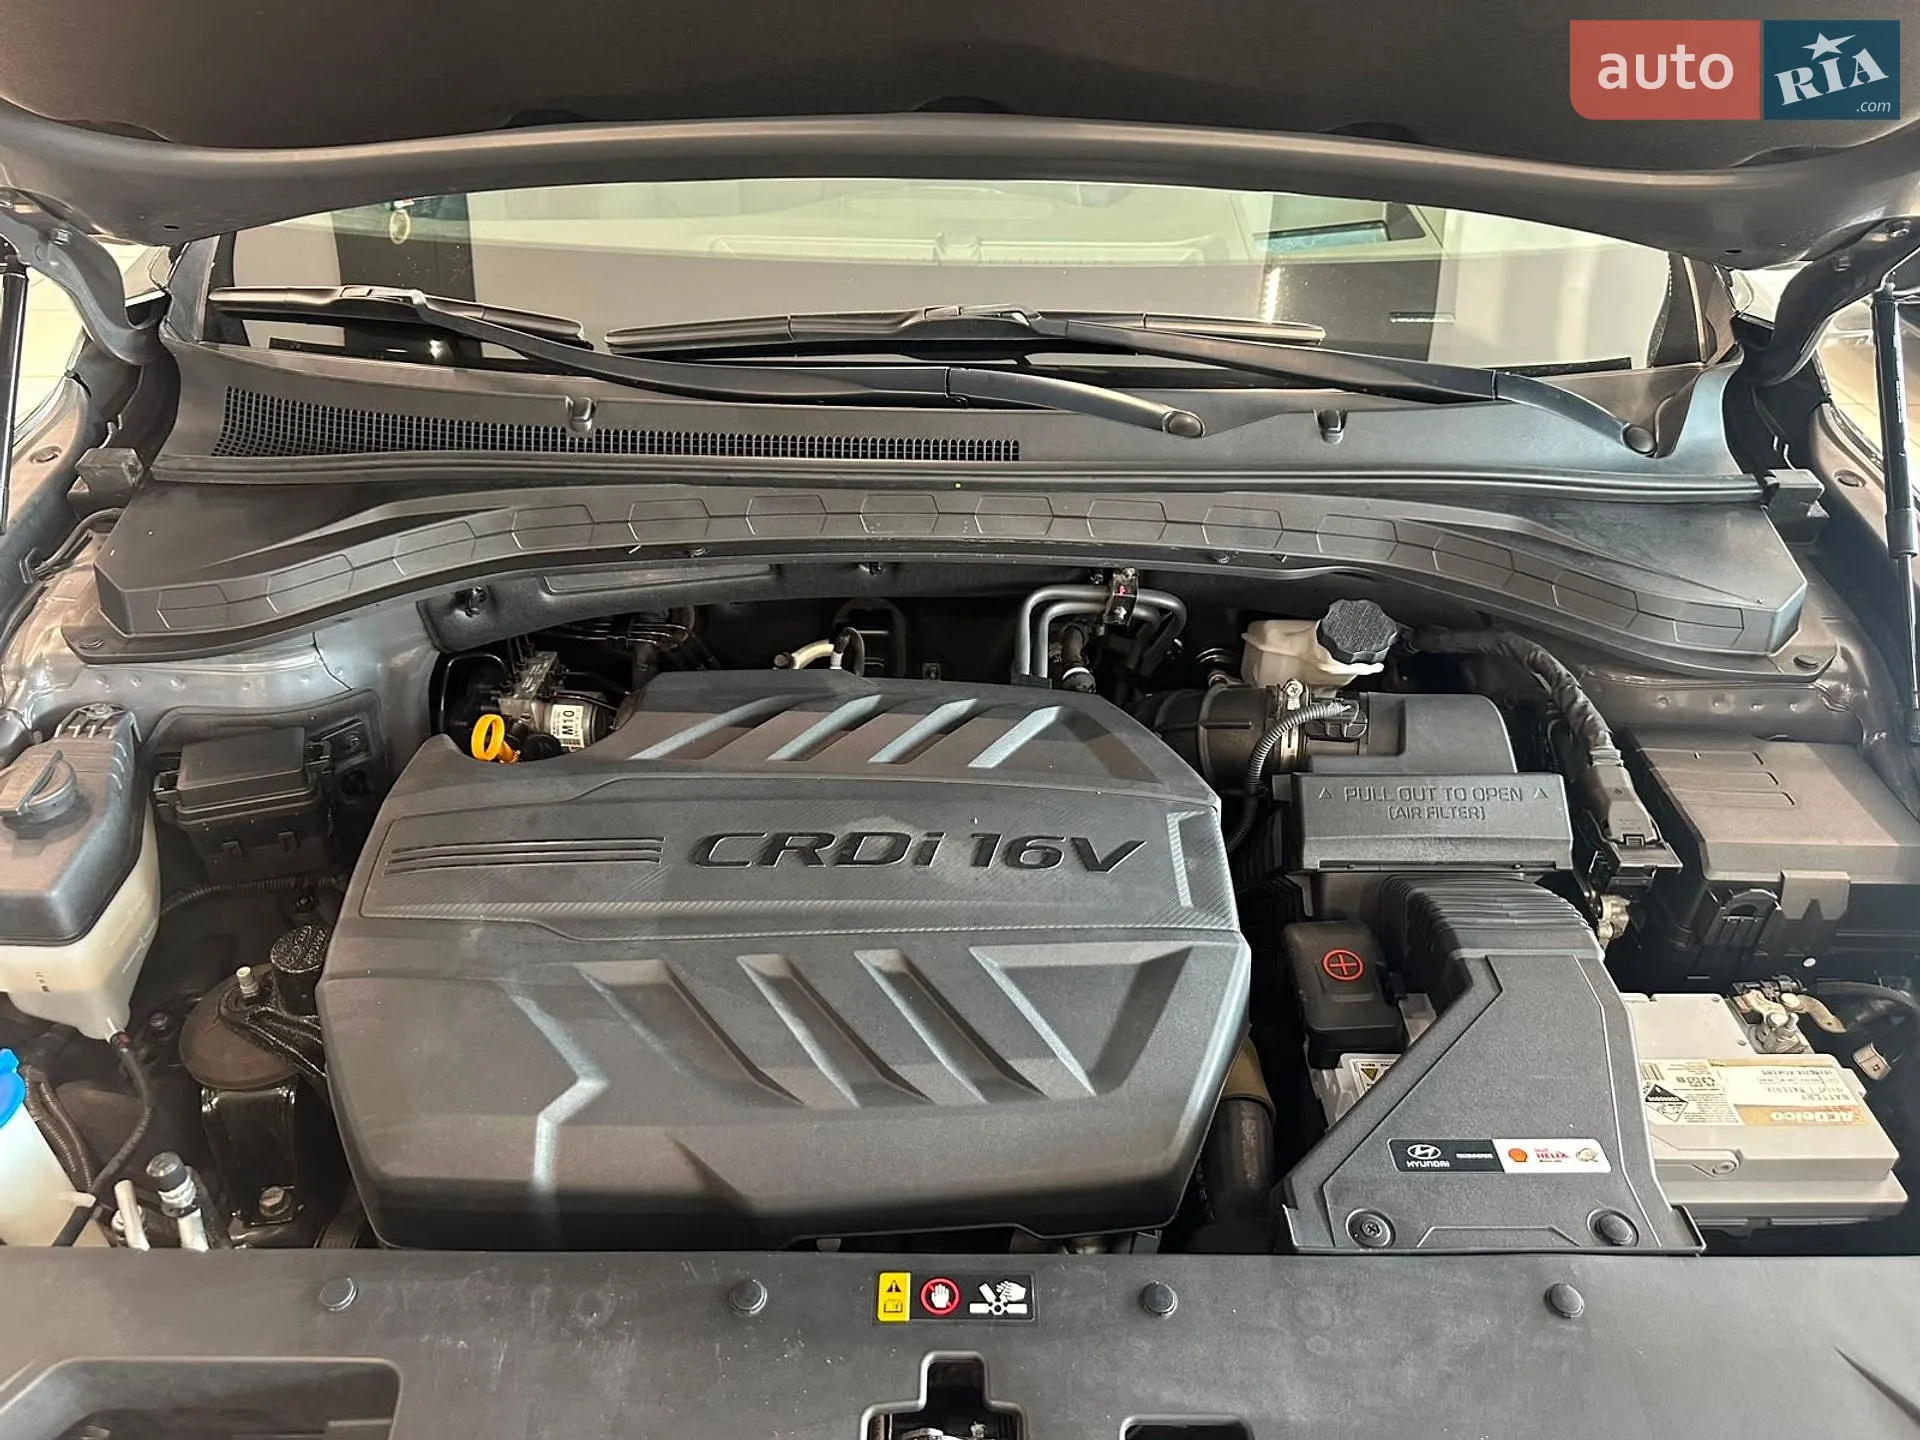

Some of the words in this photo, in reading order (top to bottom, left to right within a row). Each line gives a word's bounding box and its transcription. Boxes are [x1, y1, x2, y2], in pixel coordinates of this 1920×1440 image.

[562, 710, 575, 735] M10
[1343, 786, 1395, 802] PULL
[1397, 786, 1437, 802] OUT
[1443, 786, 1468, 802] TO
[1471, 786, 1524, 802] OPEN
[693, 830, 946, 869] CRDi
[968, 832, 1147, 874] 16V
[1406, 1160, 1450, 1168] HYUNDAI
